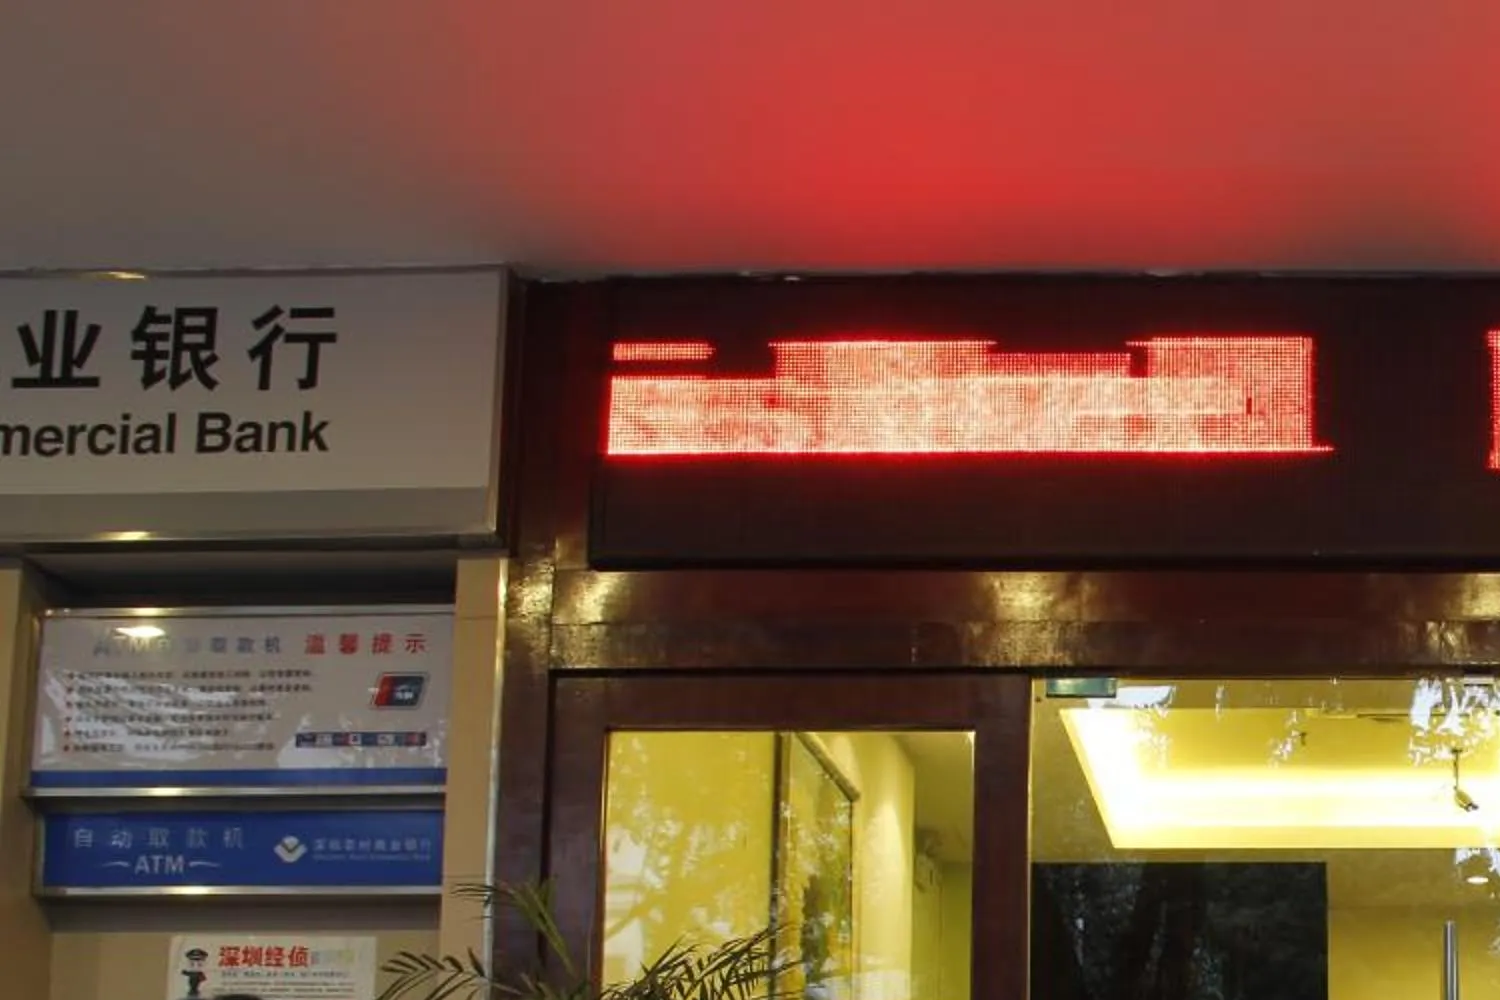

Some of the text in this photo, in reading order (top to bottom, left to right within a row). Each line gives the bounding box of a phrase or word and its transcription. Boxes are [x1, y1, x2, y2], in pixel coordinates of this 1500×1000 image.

[12, 304, 338, 391] 业银行
[0, 410, 330, 457] mercial Bank
[74, 827, 244, 850] 自动取款机
[134, 854, 186, 875] ATM
